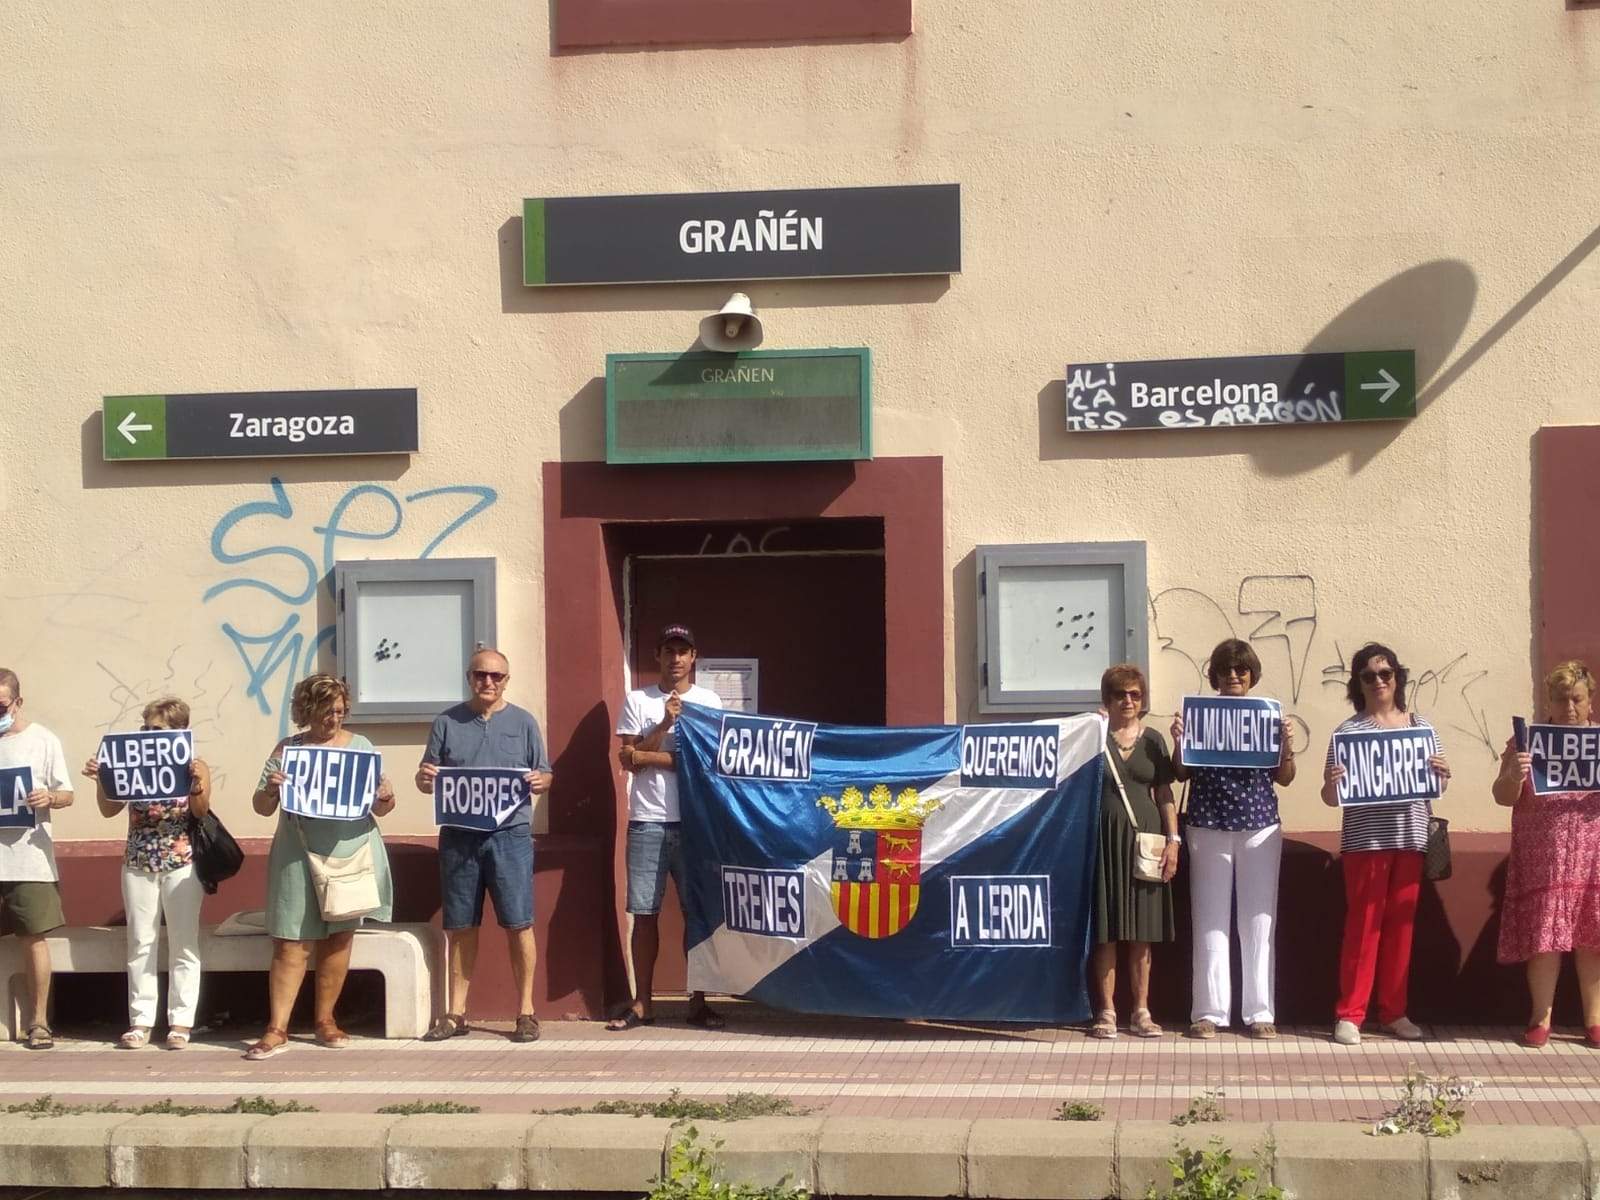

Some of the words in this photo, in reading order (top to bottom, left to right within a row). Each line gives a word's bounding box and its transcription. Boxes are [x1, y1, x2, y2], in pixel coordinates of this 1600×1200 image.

[678, 209, 824, 255] GRAÑÉN
[701, 365, 775, 384] GRAÑEN
[1130, 378, 1279, 410] Barcelona
[229, 412, 355, 442] Zaragoza
[721, 722, 811, 777] GRAÑÉN
[1183, 707, 1280, 752] ALMUNIENTE
[1530, 731, 1600, 760] ALBE
[98, 736, 191, 769] ALBERO
[961, 735, 1056, 779] QUEREMOS
[1338, 737, 1437, 799] SANGARREN
[114, 767, 176, 796] BAJO
[282, 749, 377, 818] FRAELLA
[442, 775, 522, 817] ROBRES
[725, 877, 800, 933] TRENES
[955, 884, 969, 939] A
[978, 883, 1046, 939] LERIDA
